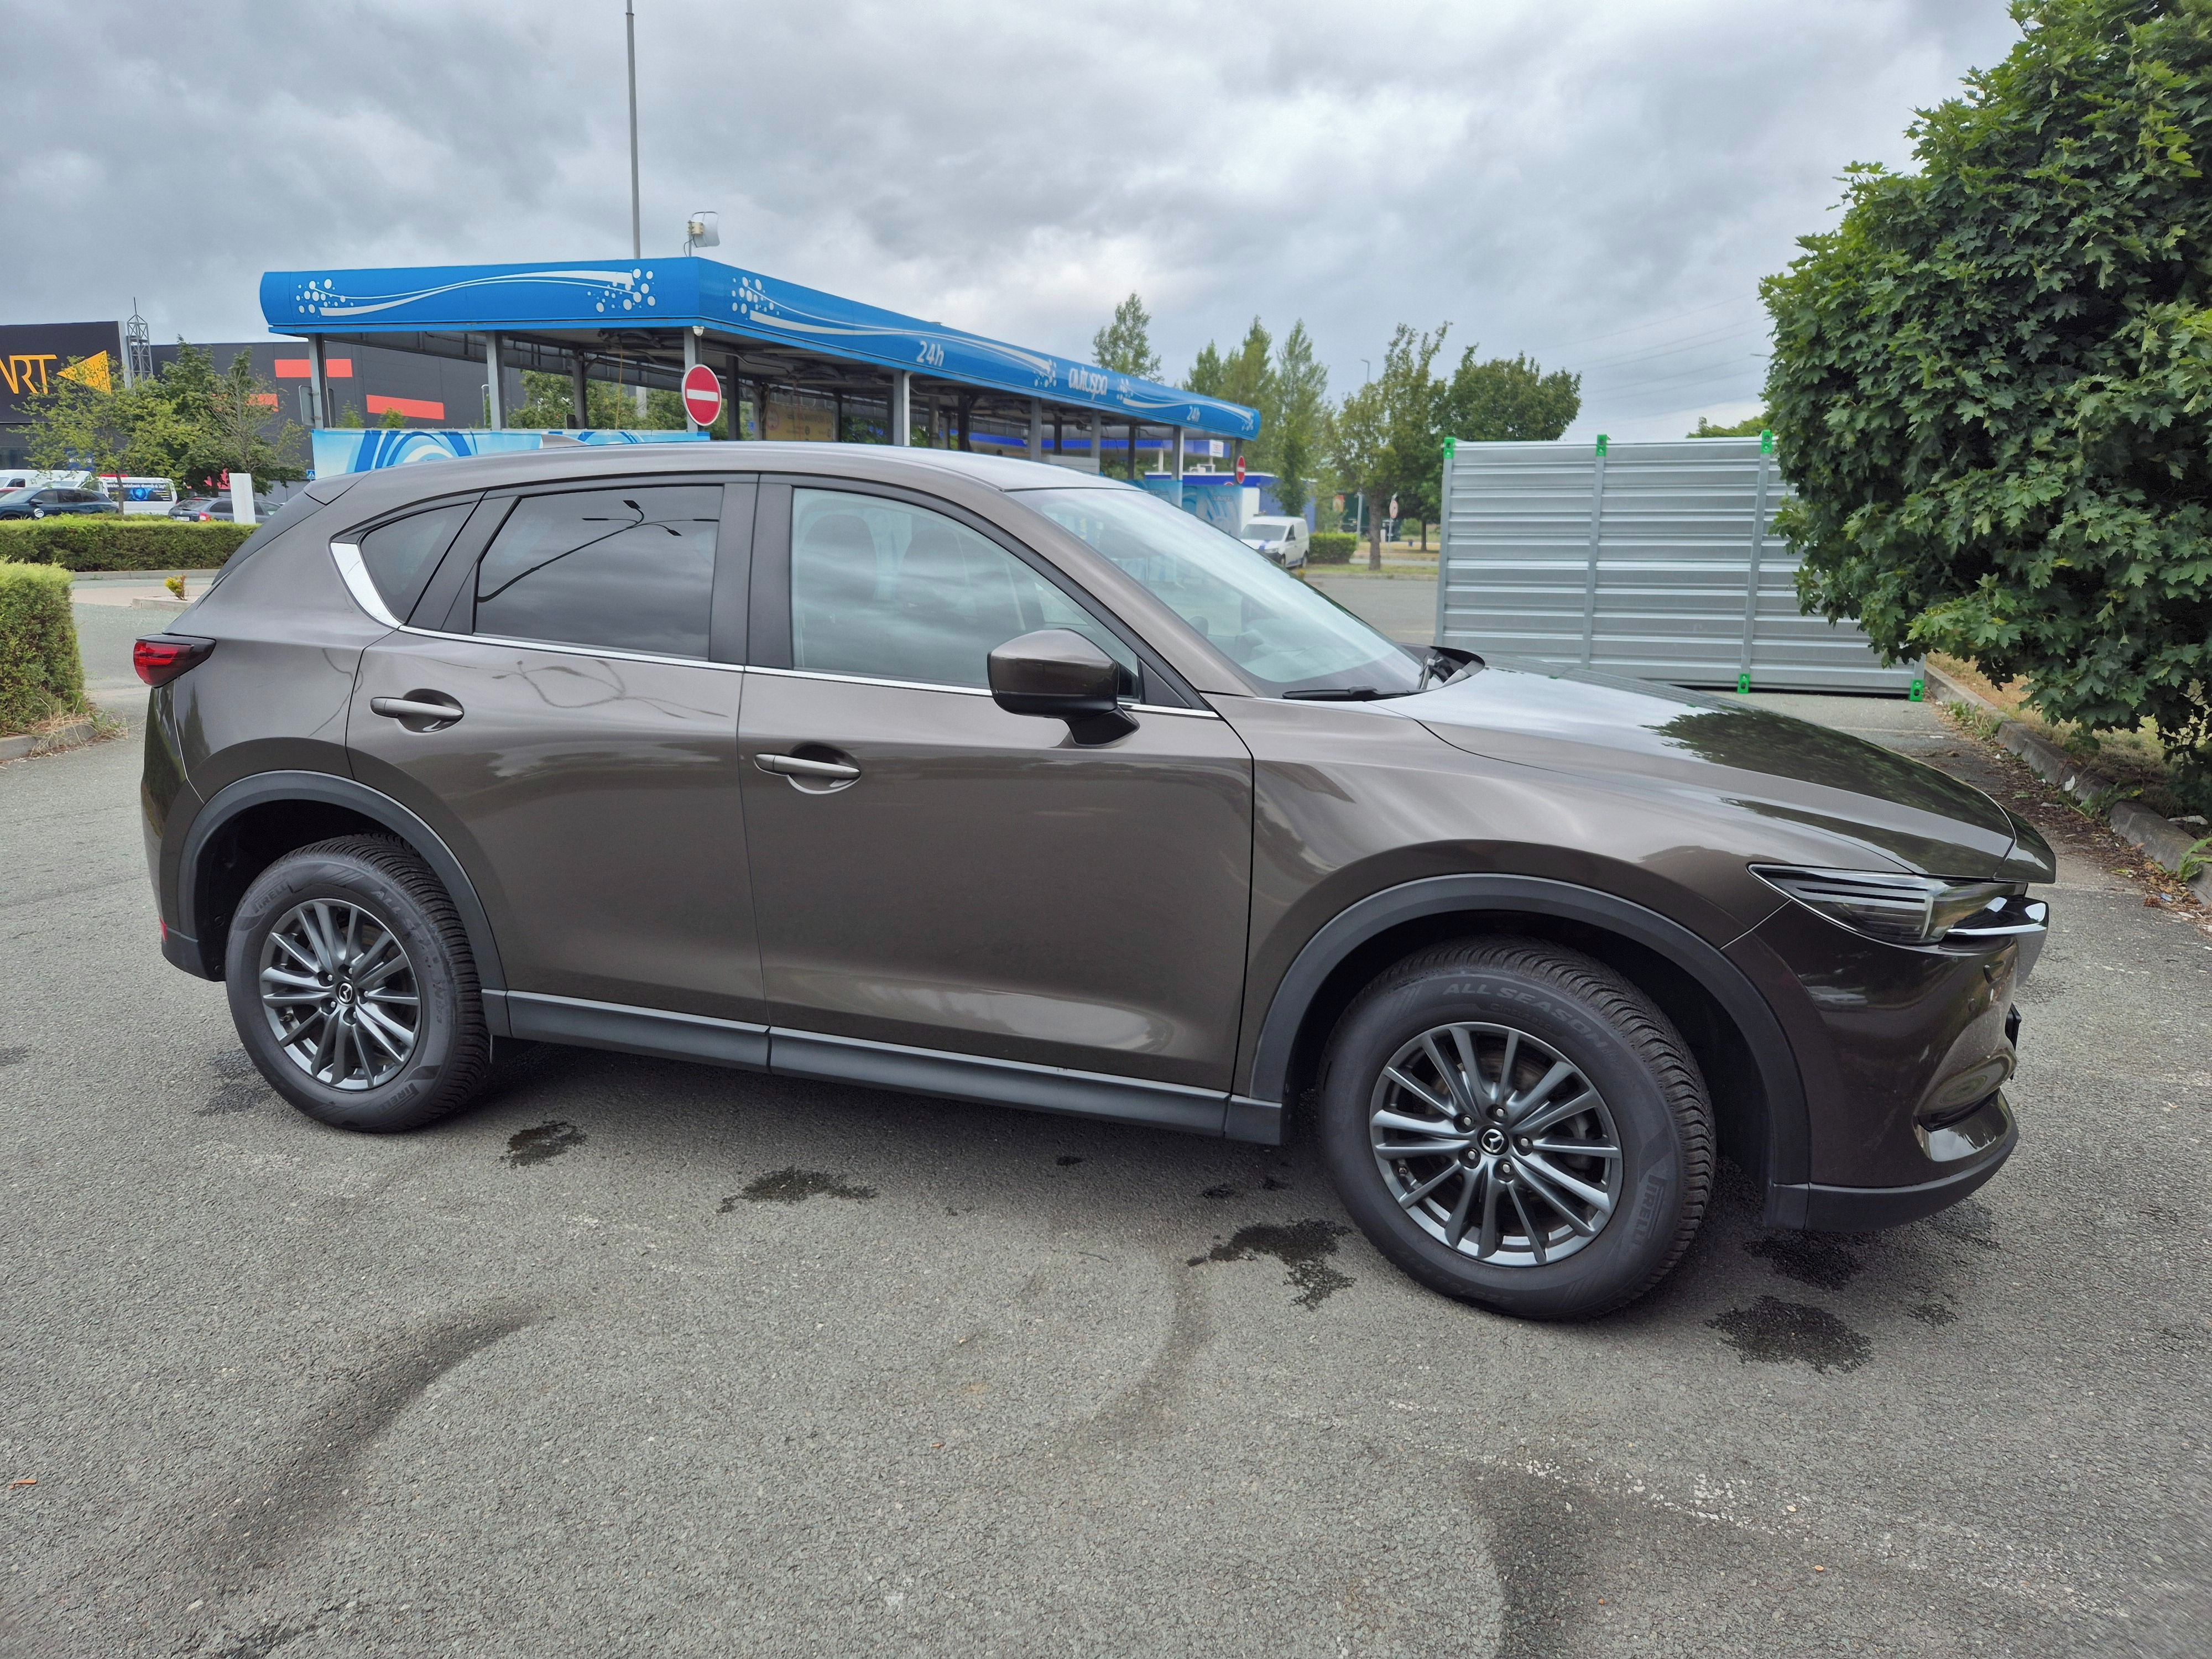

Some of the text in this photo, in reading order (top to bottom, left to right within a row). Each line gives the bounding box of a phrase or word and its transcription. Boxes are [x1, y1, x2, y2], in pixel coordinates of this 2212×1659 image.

[916, 341, 945, 367] 24h
[1068, 366, 1108, 401] autospa
[1186, 405, 1201, 422] 24h
[1443, 983, 1608, 1047] ALL SEASON
